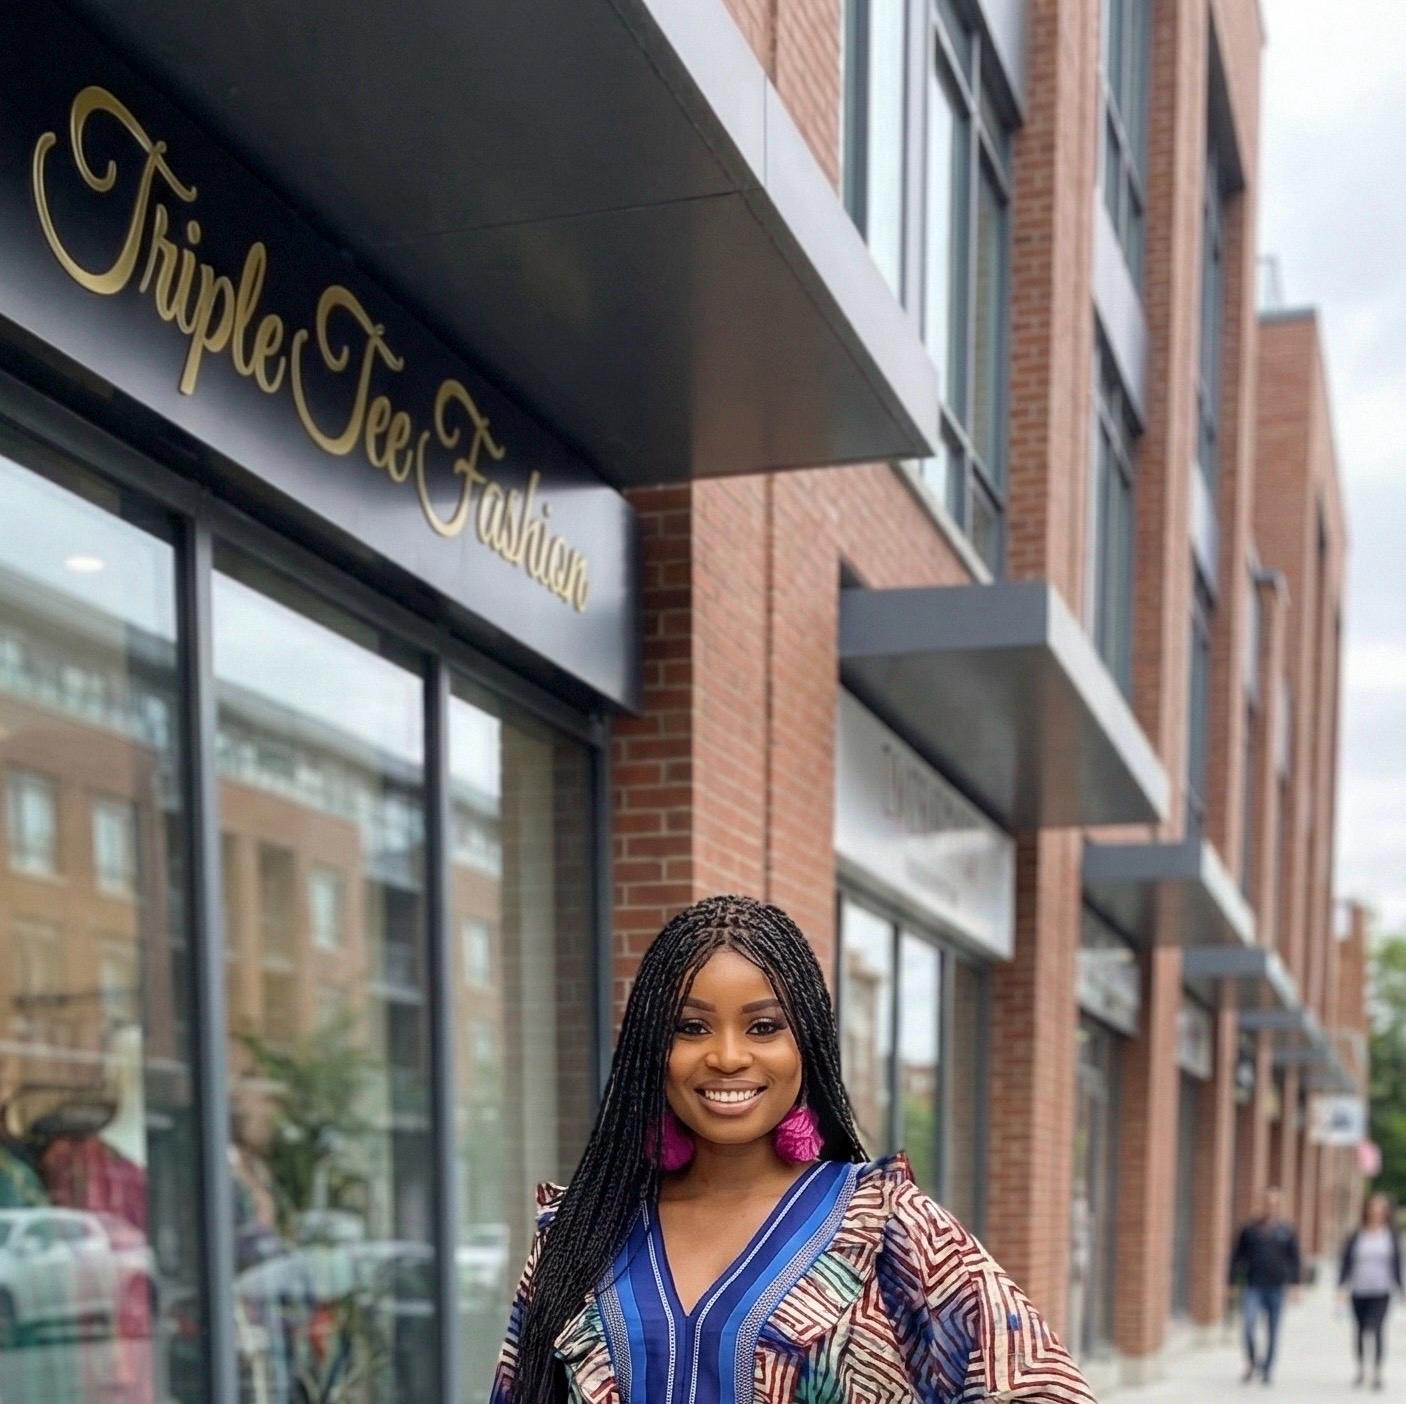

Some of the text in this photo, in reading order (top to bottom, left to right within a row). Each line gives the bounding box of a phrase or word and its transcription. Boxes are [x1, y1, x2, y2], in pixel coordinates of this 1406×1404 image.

[33, 85, 588, 613] Triple Tee Fashion
